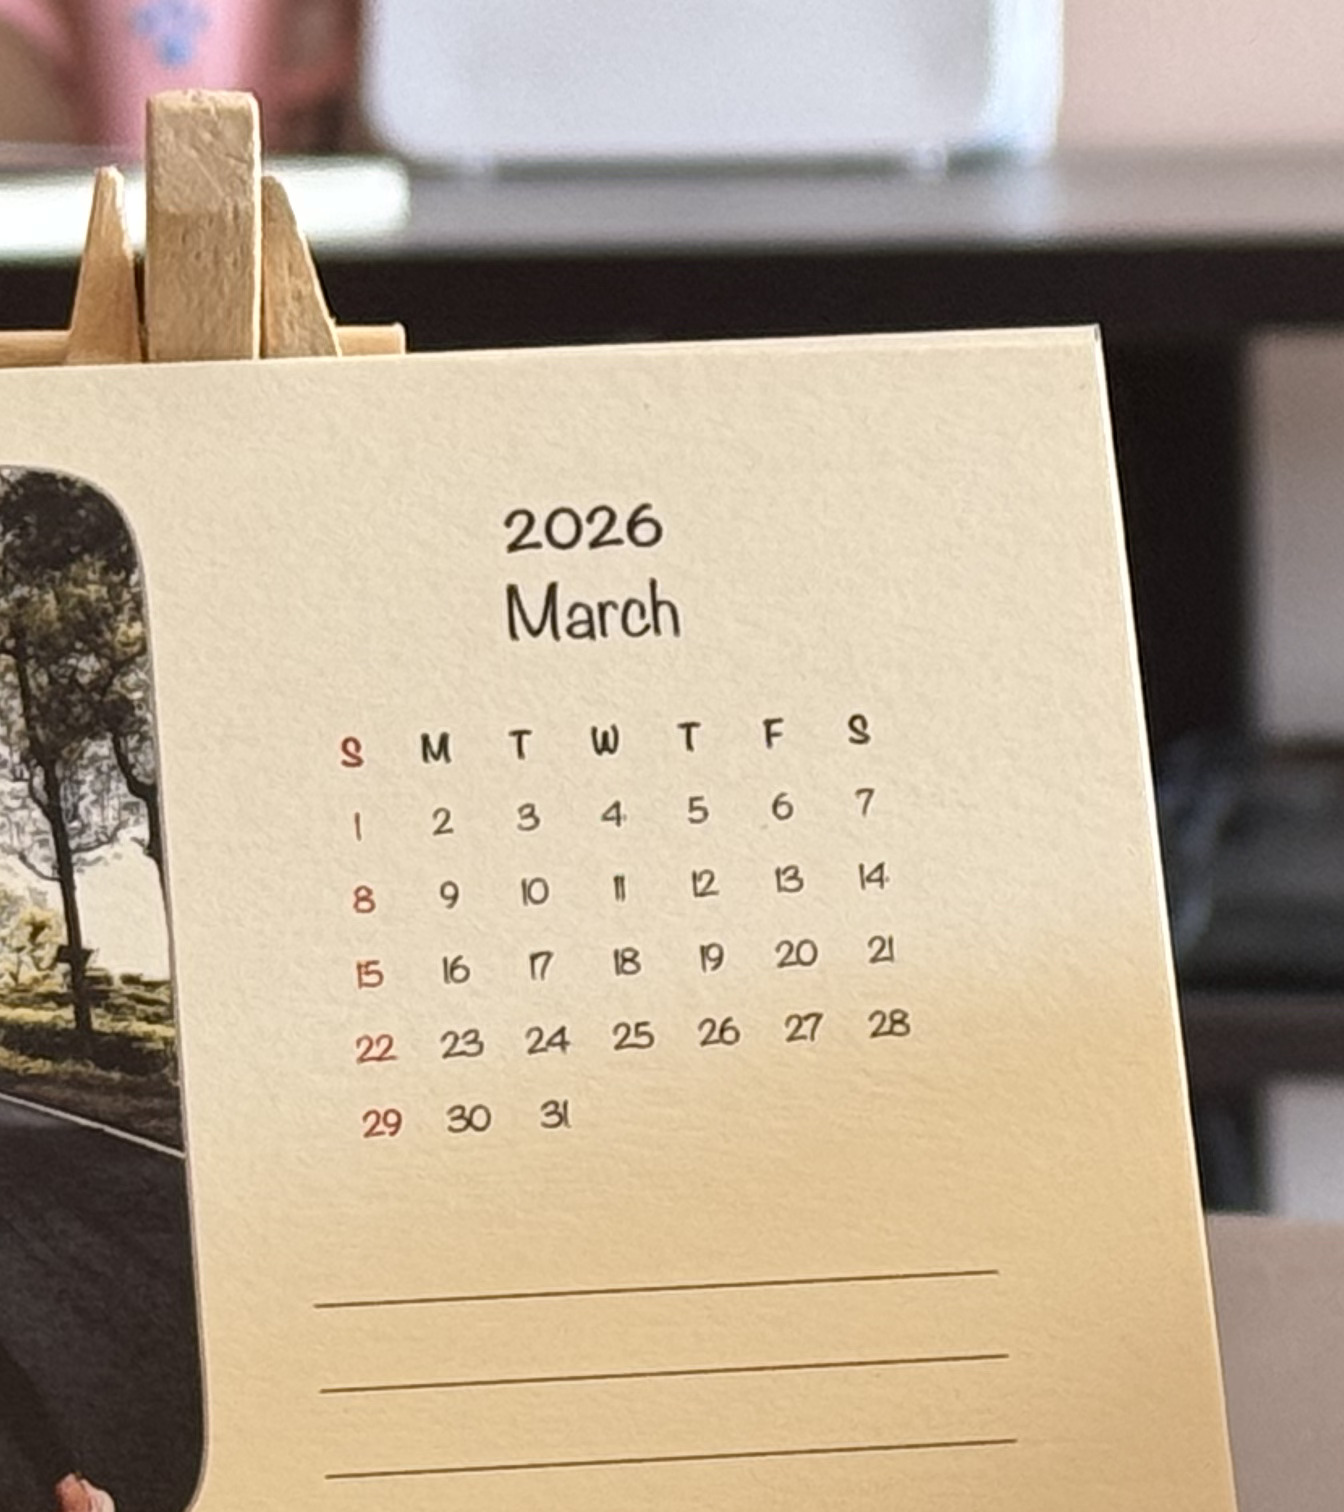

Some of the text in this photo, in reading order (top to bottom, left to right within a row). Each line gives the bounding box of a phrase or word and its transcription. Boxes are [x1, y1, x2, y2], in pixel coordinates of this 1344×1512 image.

[502, 502, 664, 555] 2026
[505, 576, 681, 643] March
[340, 712, 872, 769] S M T W T F S
[353, 787, 876, 842] 1 2 3 4 5 6 7
[352, 860, 891, 915] 8 9 10 11 12 13 14
[355, 934, 896, 991] 15 16 17 18 19 20 21
[355, 1007, 912, 1066] 22 23 24 25 26 27 28
[361, 1098, 573, 1139] 29 30 31
